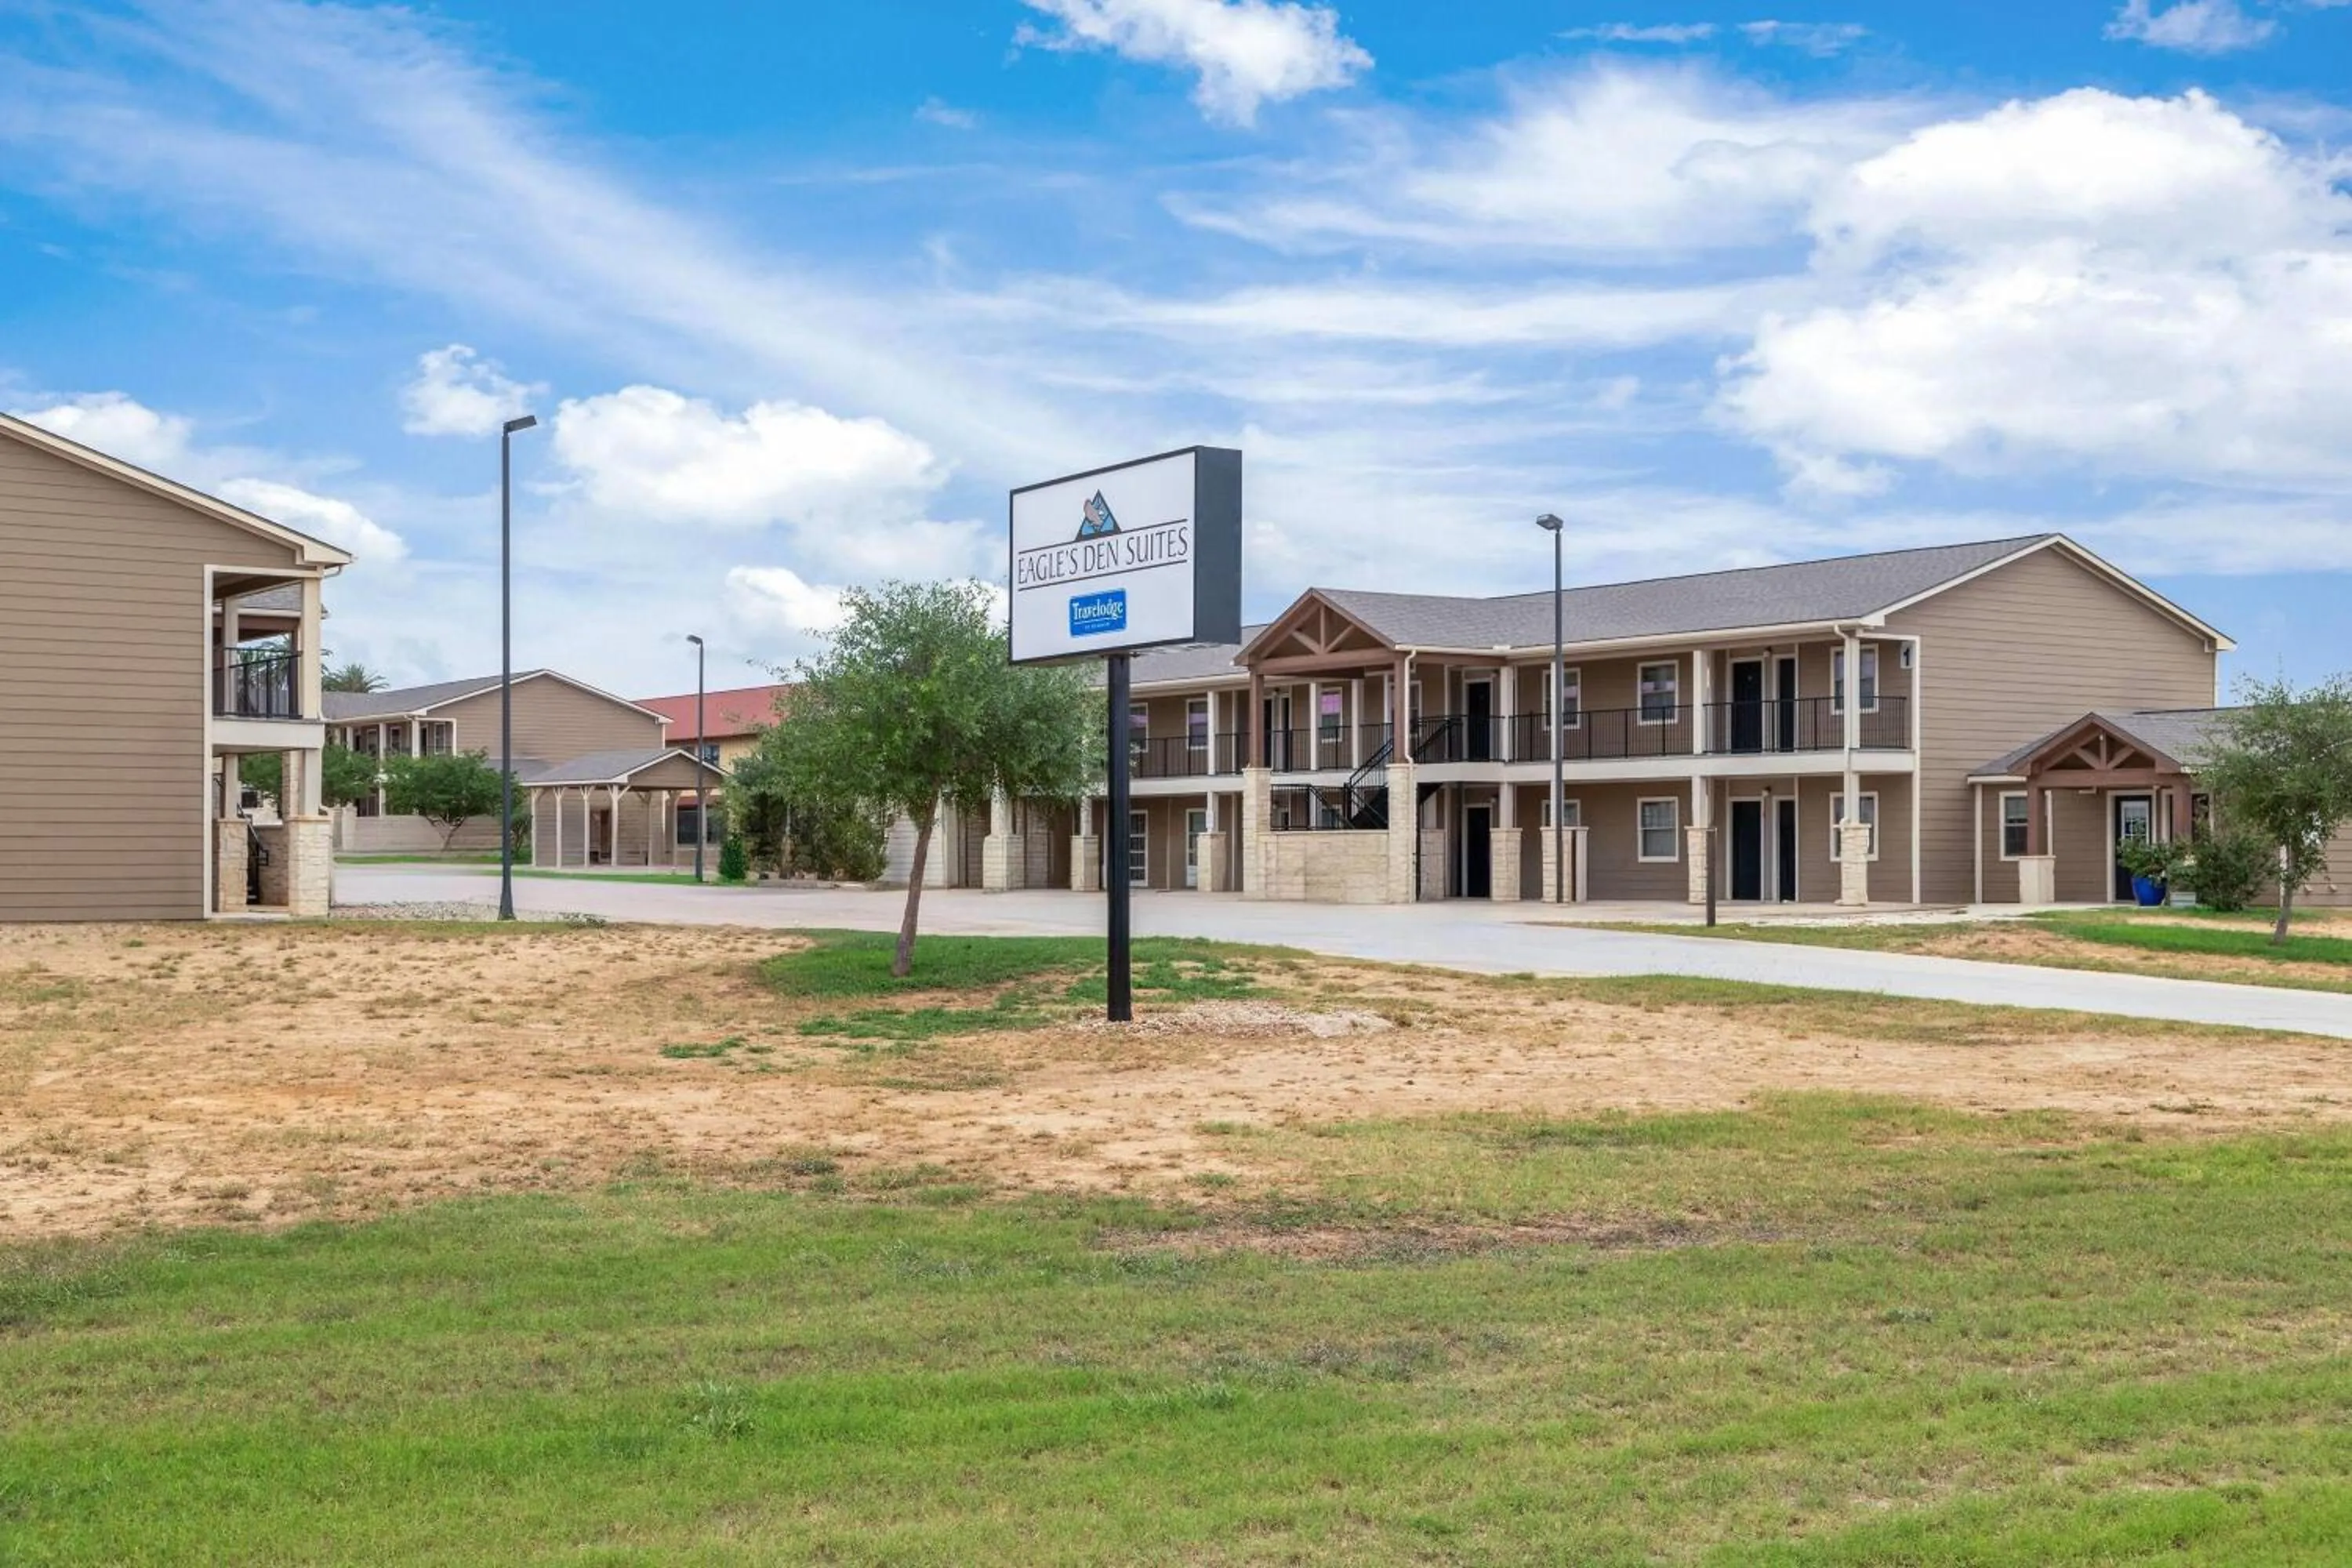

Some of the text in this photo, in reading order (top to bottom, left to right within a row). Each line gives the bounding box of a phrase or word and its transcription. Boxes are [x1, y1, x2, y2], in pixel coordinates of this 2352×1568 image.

[1018, 526, 1188, 584] EAGLE'S DEN SUITES
[1073, 598, 1123, 619] Travelodge
